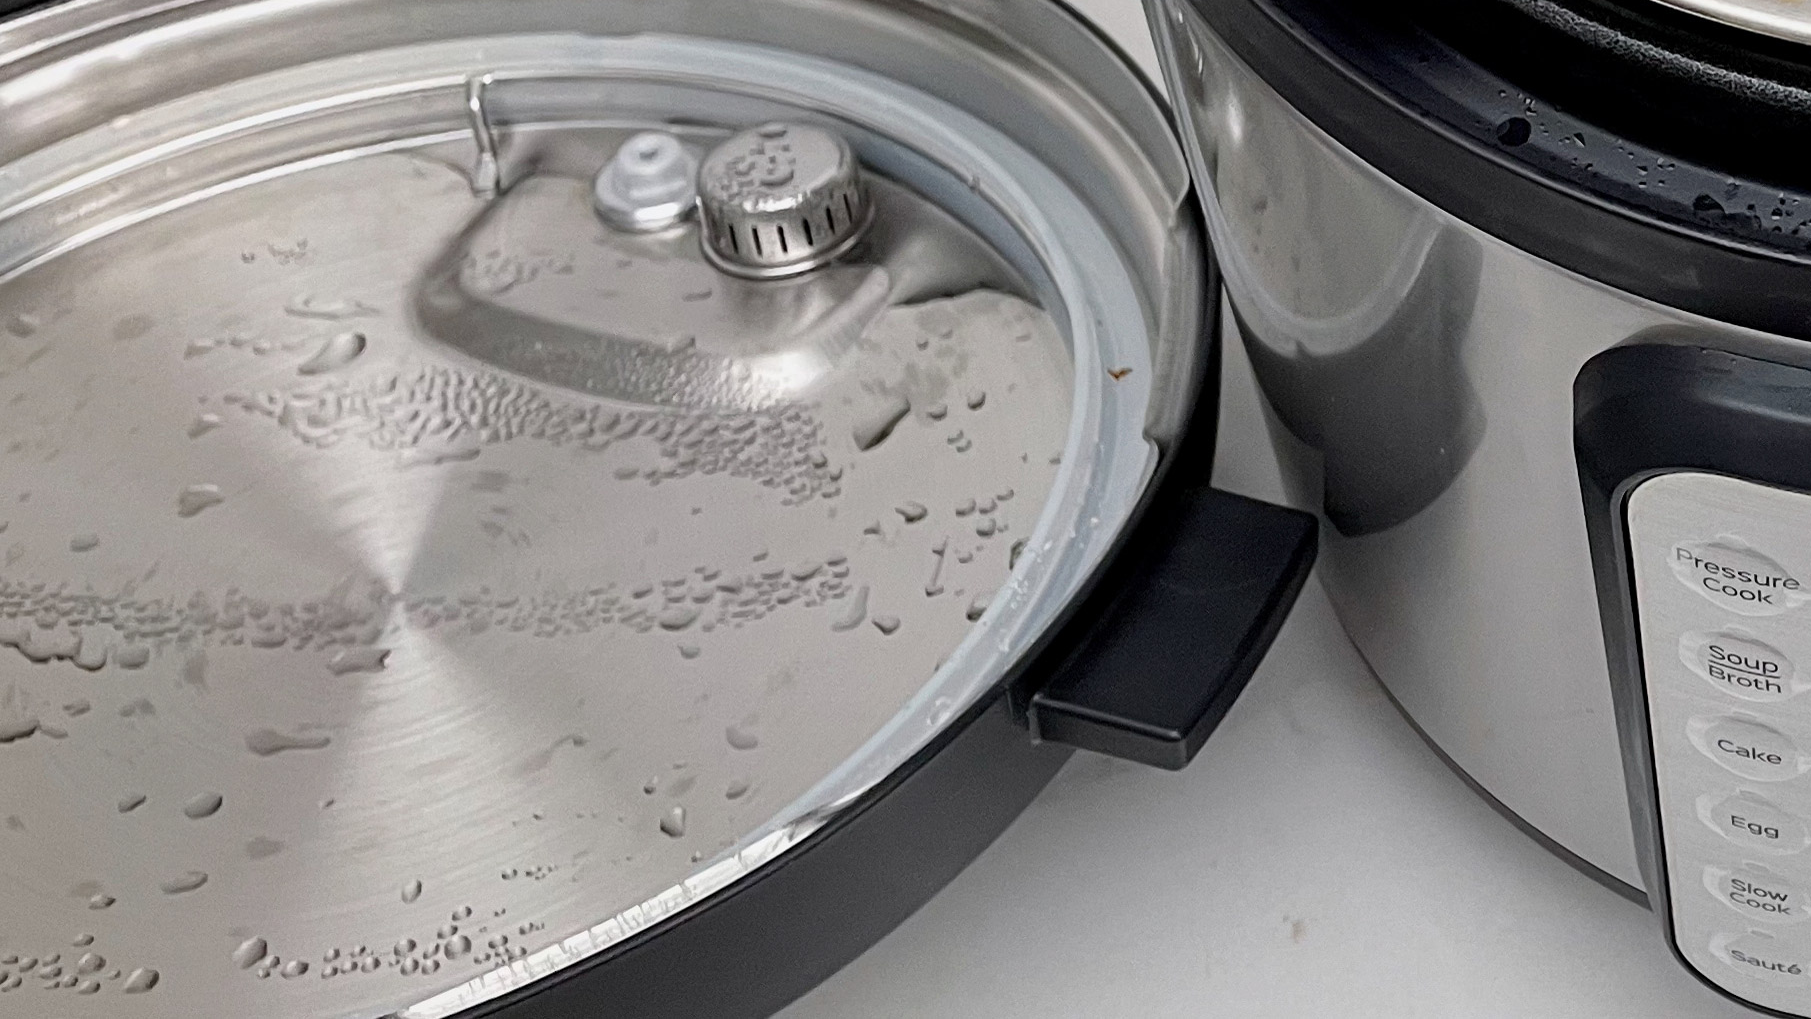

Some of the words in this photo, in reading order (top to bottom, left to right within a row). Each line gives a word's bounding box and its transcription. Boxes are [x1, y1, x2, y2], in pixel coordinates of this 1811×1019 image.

[1676, 547, 1801, 591] Pressure
[1703, 577, 1774, 605] Cook
[1708, 644, 1779, 675] Soup
[1708, 664, 1782, 694] Broth
[1717, 738, 1783, 765] Cake
[1730, 814, 1780, 840] Egg
[1729, 891, 1791, 916] Cook
[1731, 878, 1788, 903] Slow
